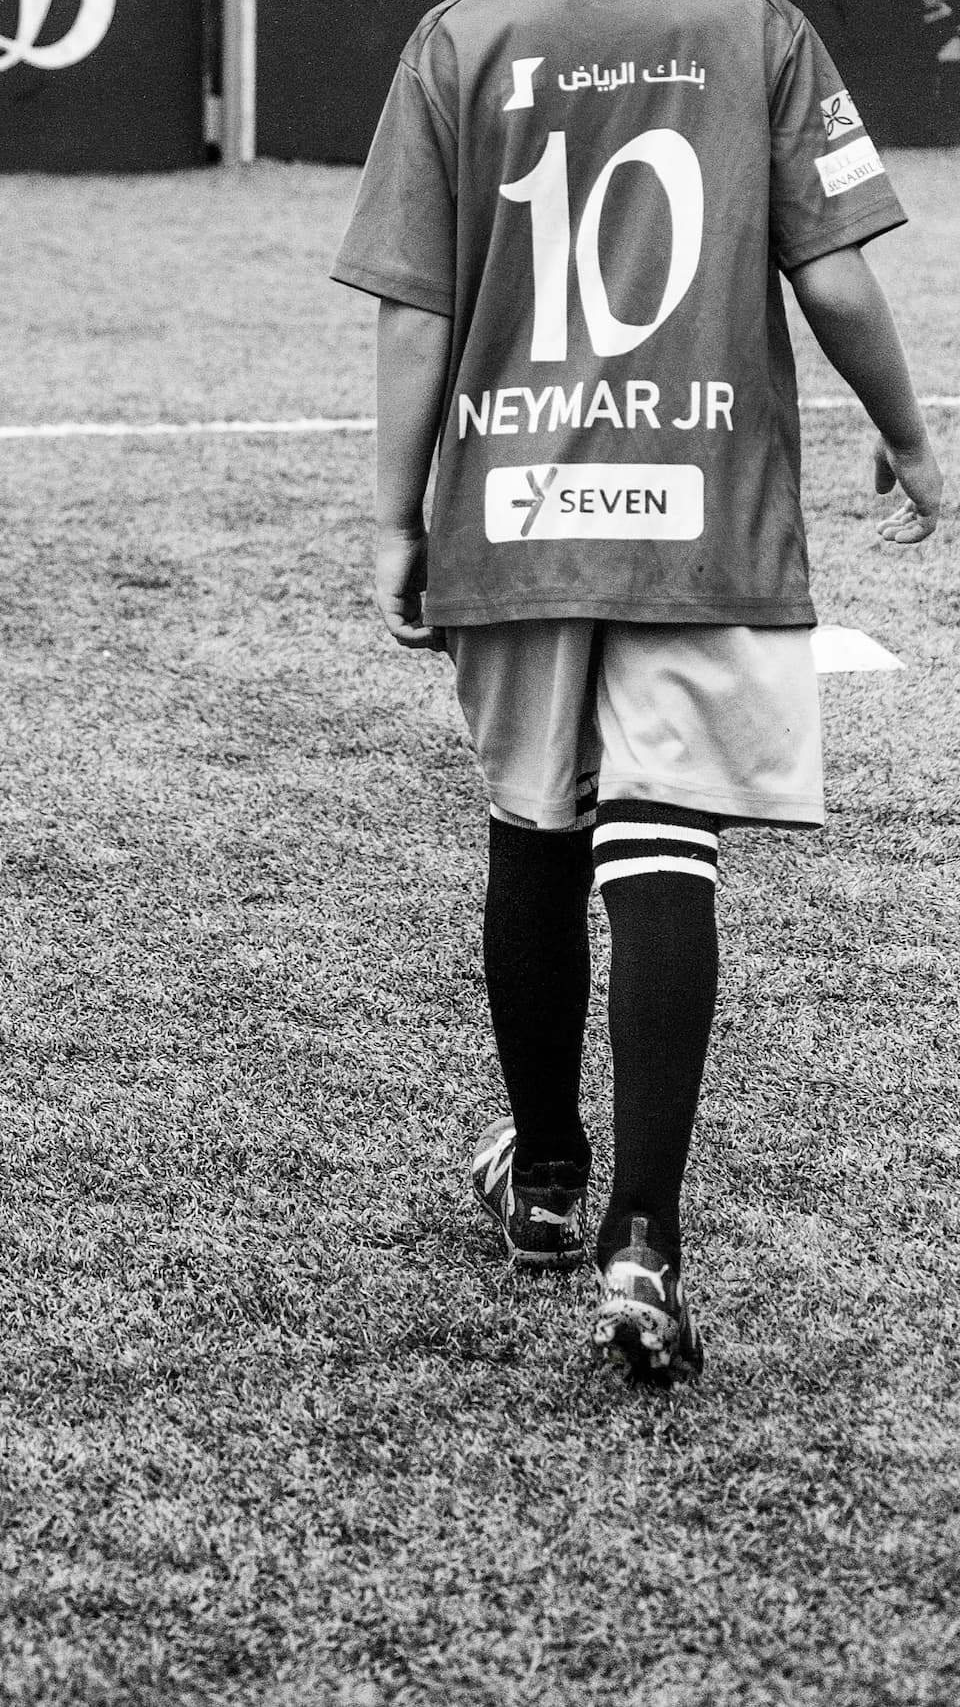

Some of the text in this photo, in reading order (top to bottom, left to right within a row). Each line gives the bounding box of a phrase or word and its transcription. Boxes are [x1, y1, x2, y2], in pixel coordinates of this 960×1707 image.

[558, 59, 706, 92] بنك الرياض
[499, 128, 704, 362] 10
[458, 379, 735, 439] NEYMAR JR
[559, 489, 667, 515] SEVEN
